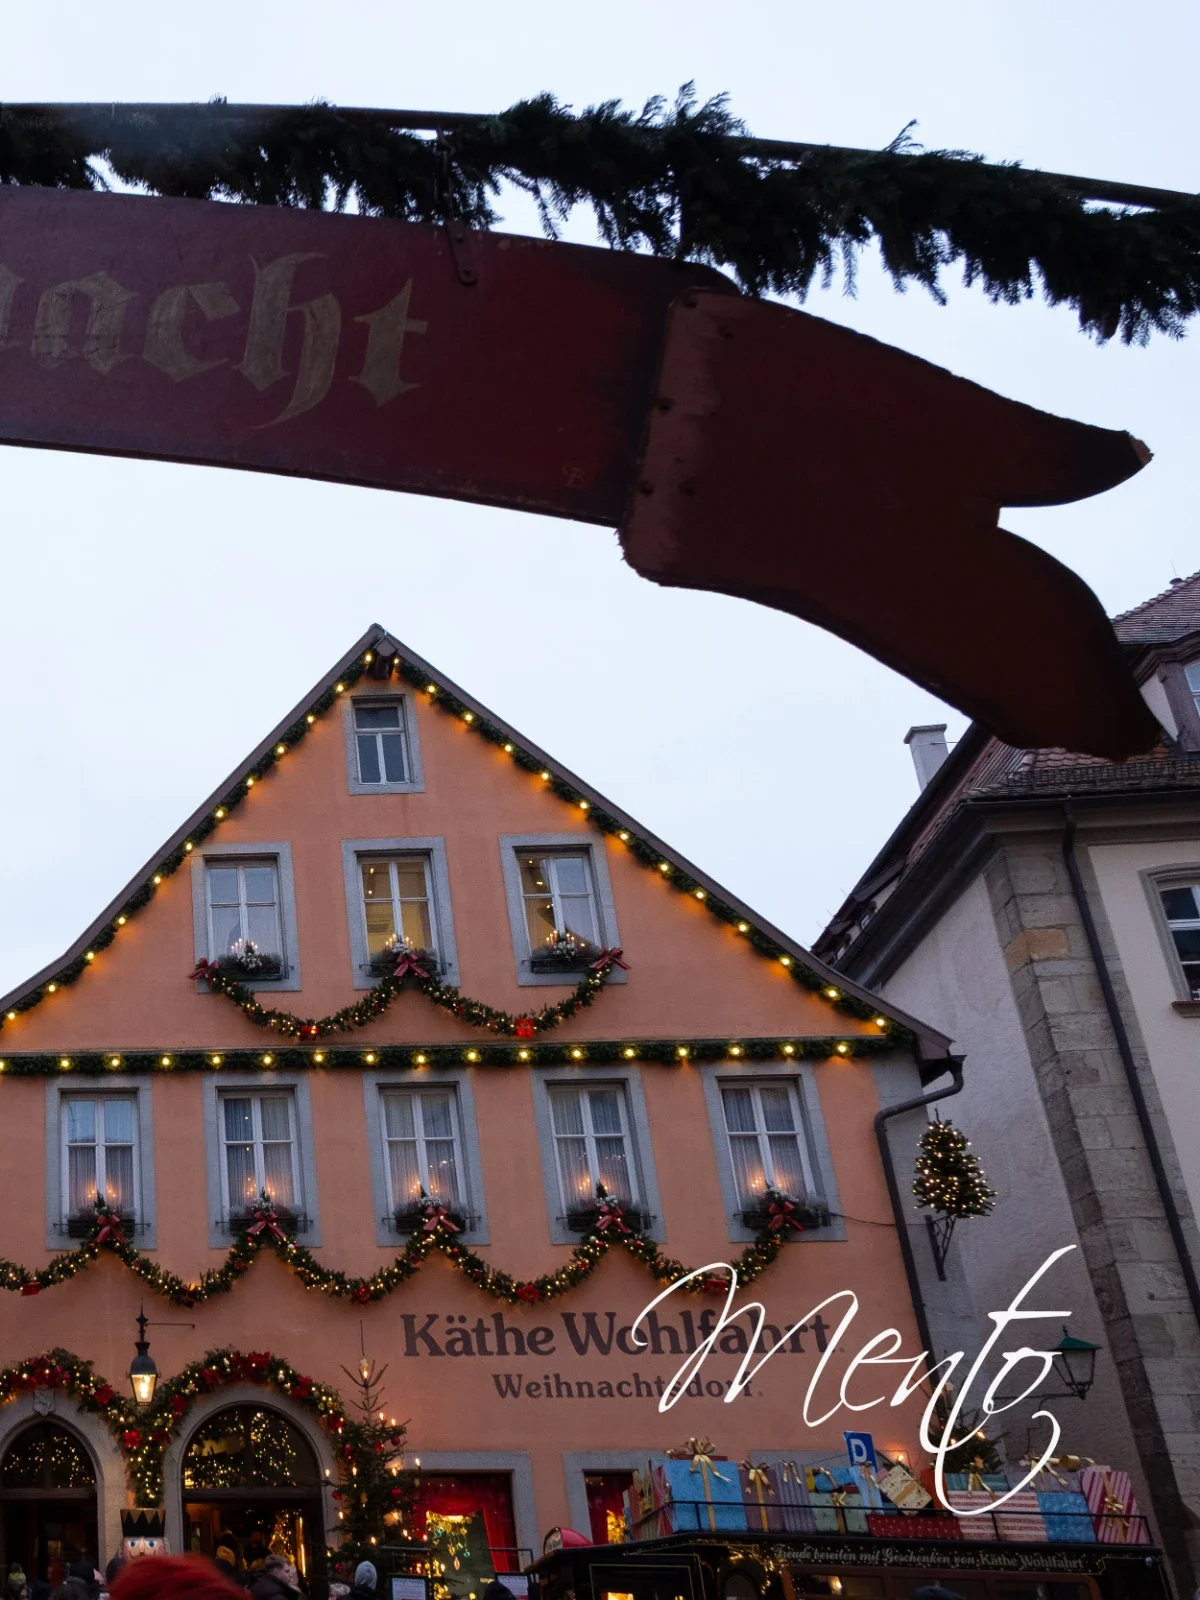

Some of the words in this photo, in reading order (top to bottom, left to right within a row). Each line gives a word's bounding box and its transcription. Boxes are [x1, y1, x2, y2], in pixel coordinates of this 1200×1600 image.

[400, 1313, 555, 1357] Käthe
[860, 1549, 880, 1562] mit
[882, 1547, 950, 1565] Geschenken
[979, 1552, 1018, 1567] Käthe
[1018, 1554, 1085, 1569] Wohlfahrt
